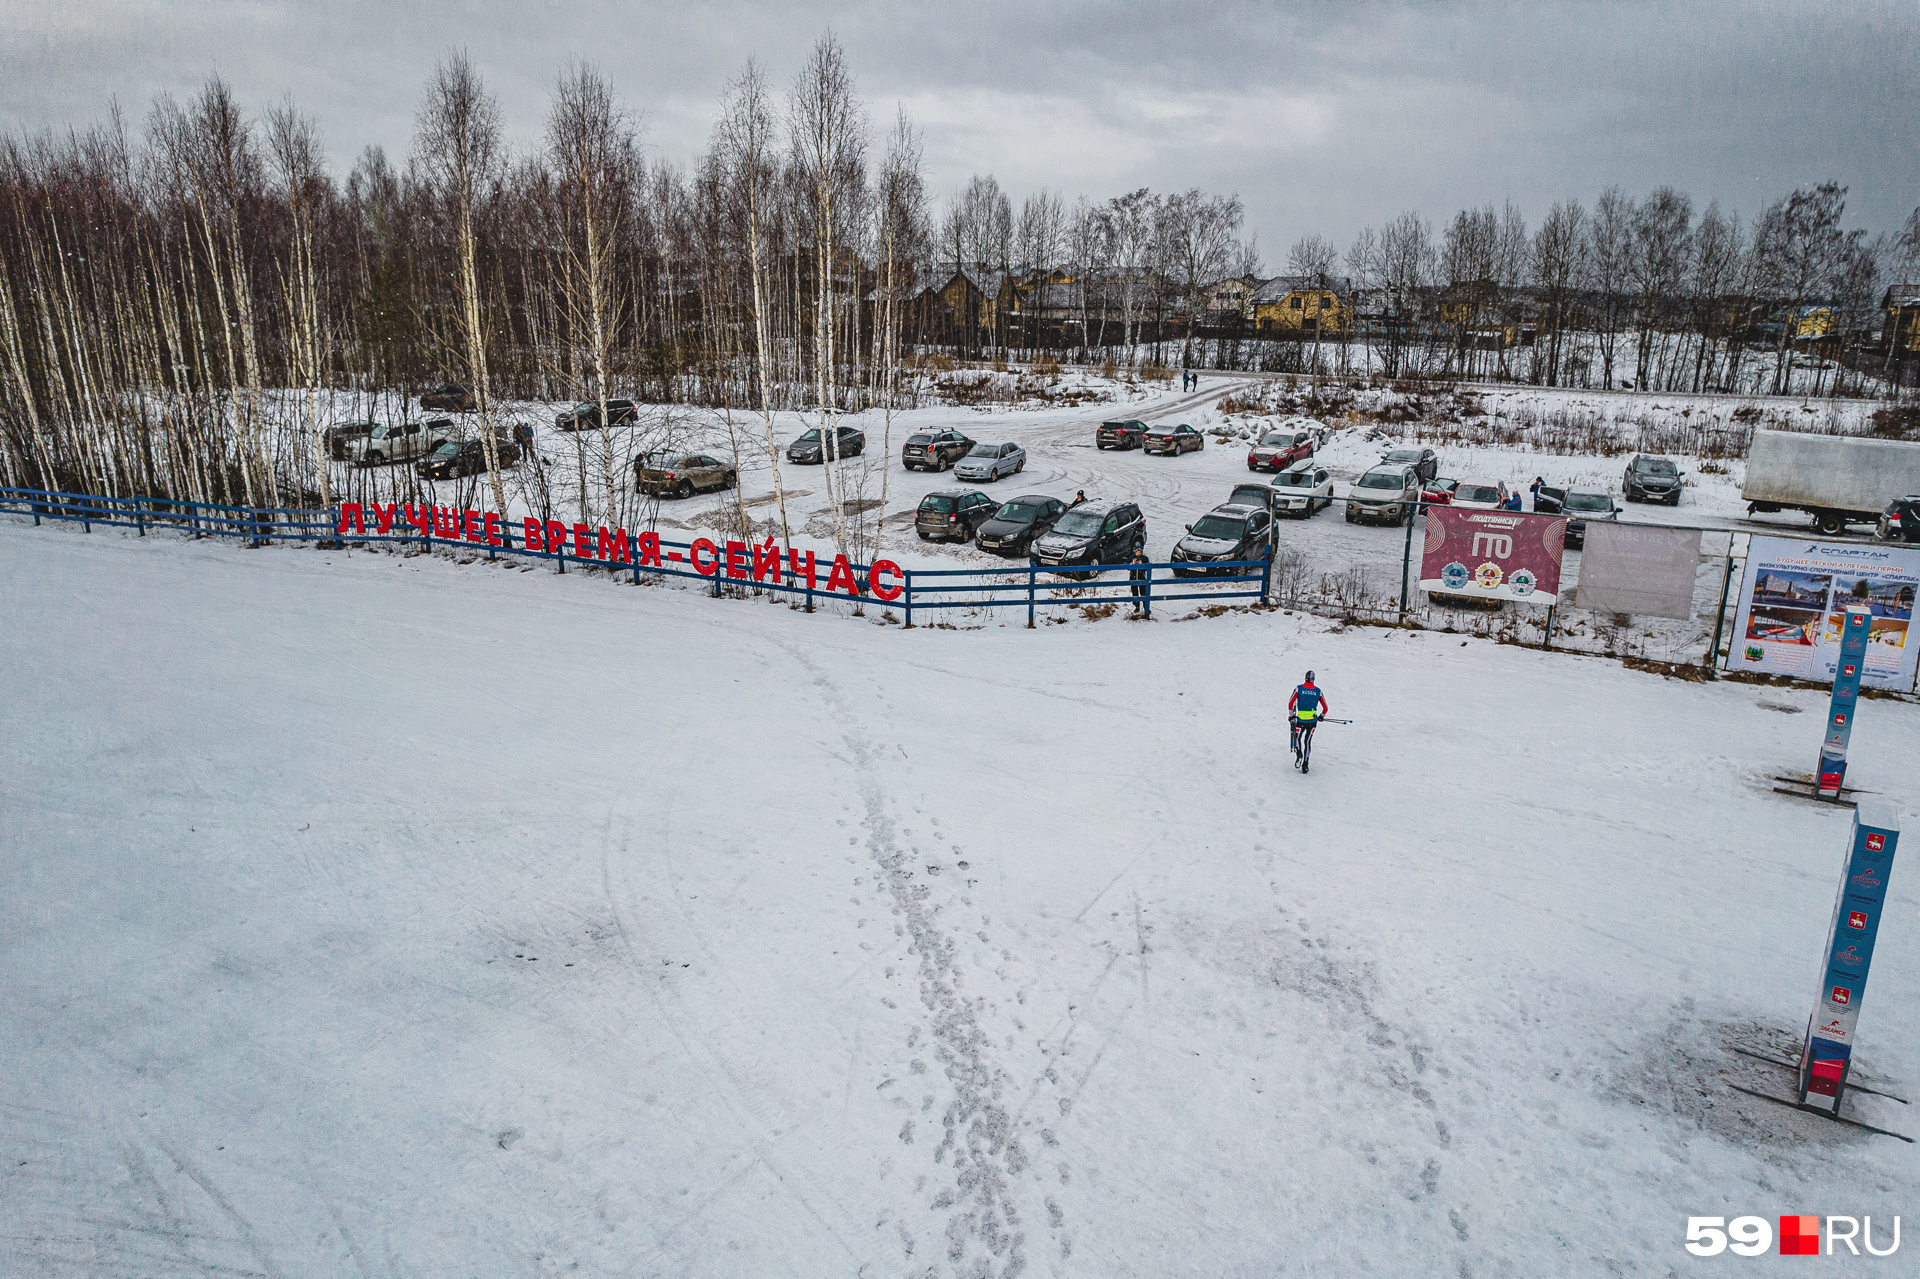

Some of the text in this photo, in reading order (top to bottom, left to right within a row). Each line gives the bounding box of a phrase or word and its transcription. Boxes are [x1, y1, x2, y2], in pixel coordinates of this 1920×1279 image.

[337, 503, 501, 546] ЛУЧШЕЕ
[1471, 531, 1513, 560] ГТО
[1820, 547, 1890, 559] СПАРТАК
[1757, 562, 1919, 582] ФИЗКУЛЬТУРНО-СПОРТИВНЫЙ ЦЕНТР «СПАРТАК»
[1776, 556, 1808, 566] БУДУЩЕЕ
[1838, 562, 1876, 571] АТЛЕТИКИ
[1877, 565, 1904, 574] ПЕРМИ
